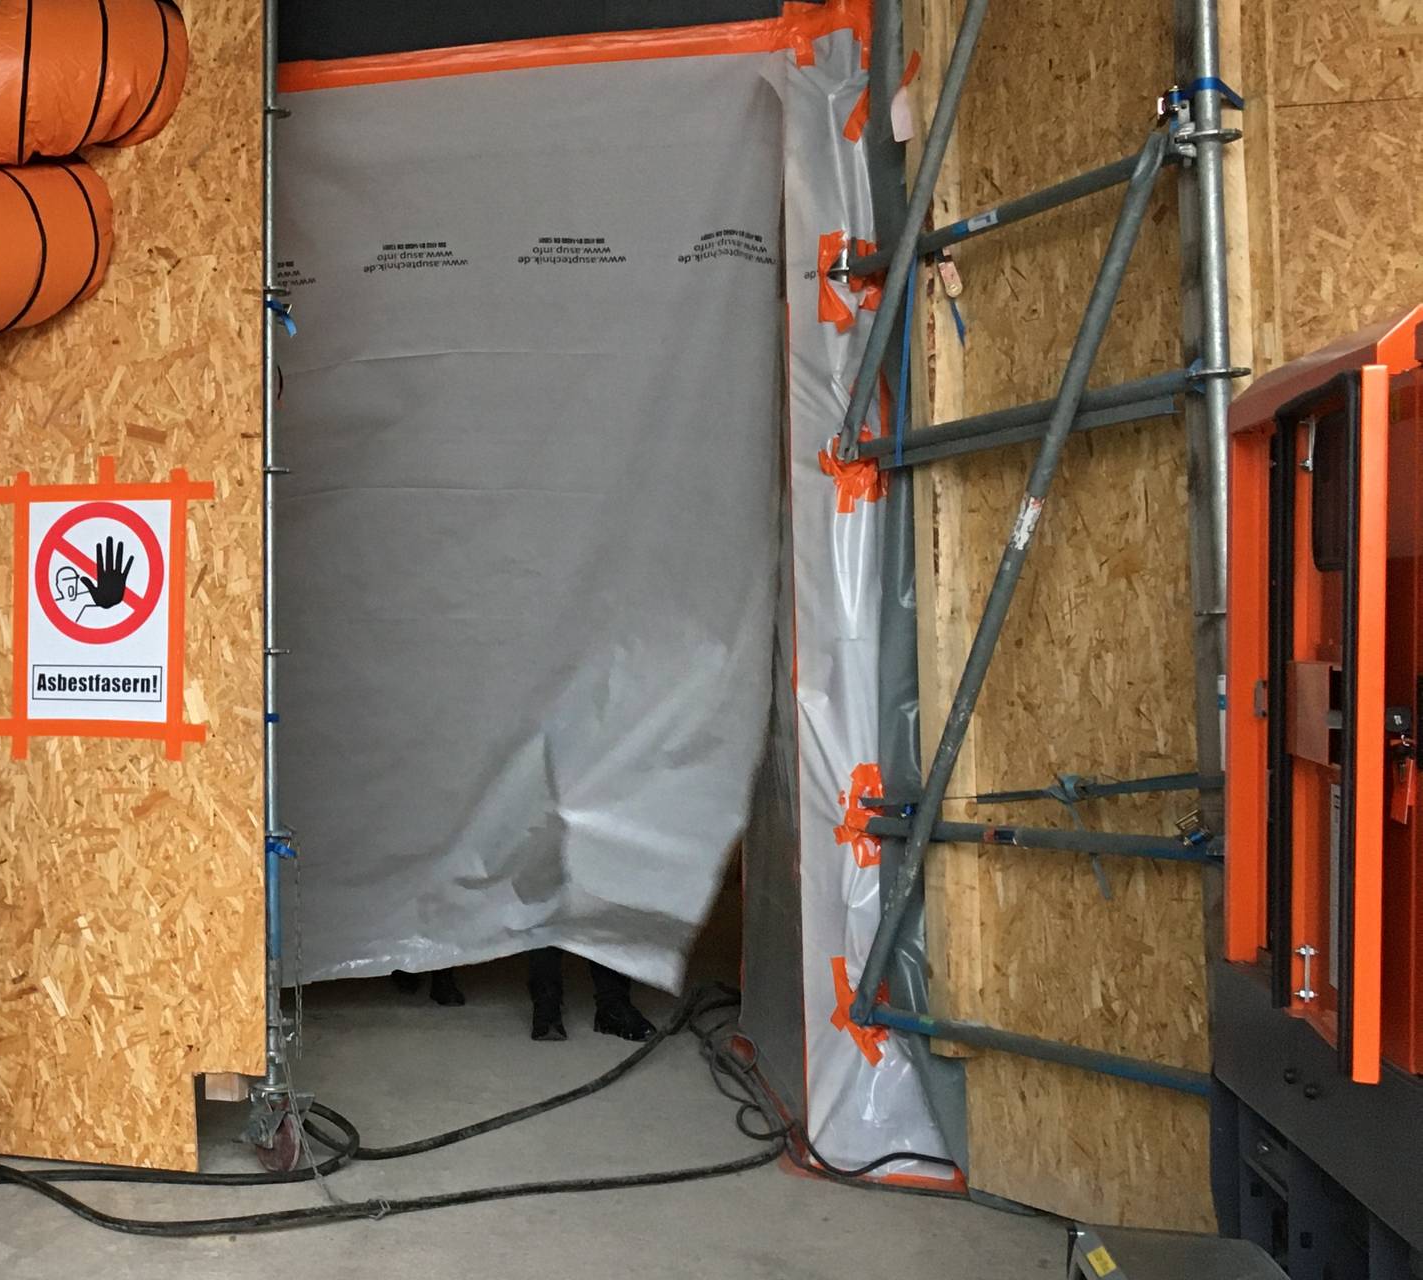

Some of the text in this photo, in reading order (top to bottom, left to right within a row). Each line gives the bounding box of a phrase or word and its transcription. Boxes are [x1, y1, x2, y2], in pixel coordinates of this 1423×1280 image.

[364, 258, 469, 273] www.asuptechnik.de
[518, 255, 627, 265] www.asuptechnik.de
[37, 673, 157, 693] Asbestfasern!
